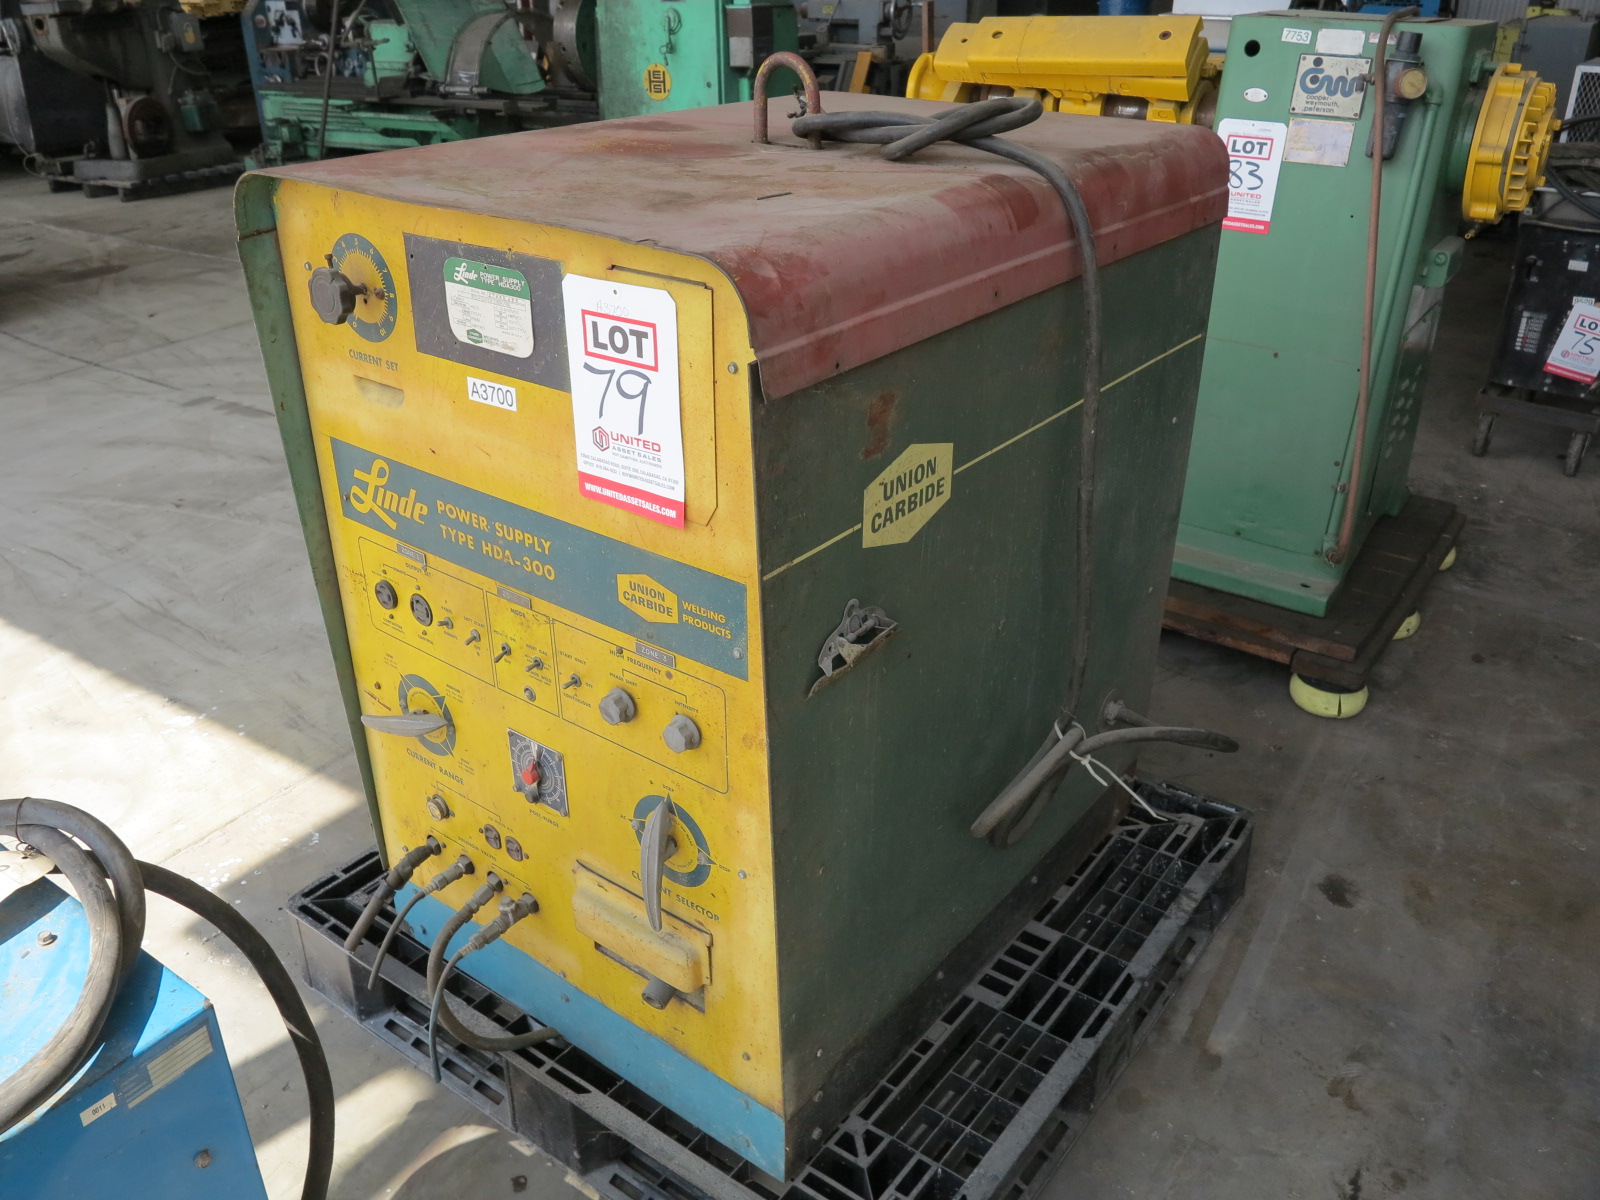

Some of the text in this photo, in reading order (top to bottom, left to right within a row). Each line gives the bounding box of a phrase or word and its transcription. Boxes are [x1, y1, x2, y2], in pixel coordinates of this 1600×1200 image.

[1284, 30, 1310, 42] 7753
[1231, 140, 1268, 155] LOT
[1229, 160, 1264, 190] 83
[1230, 191, 1262, 200] UNITED
[454, 262, 525, 286] Linde POWER SUPPLY
[1579, 318, 1600, 333] LO
[591, 320, 648, 359] LOT
[1571, 330, 1600, 355] 75
[349, 350, 398, 372] CURRENT SET
[471, 382, 514, 408] A3700
[583, 362, 652, 436] 79
[610, 430, 661, 452] UNITED
[612, 446, 662, 462] ASSET SALES
[882, 456, 937, 502] UNION
[350, 459, 552, 555] Linde POWER SUPPLY
[584, 482, 676, 518] WWW.UNITEDASSETSALES.COM
[870, 476, 945, 534] CARBIDE
[402, 546, 415, 558] ZONE
[440, 524, 555, 580] TYPE HDA-300
[629, 580, 666, 602] UNION
[510, 608, 526, 618] MODE
[622, 590, 673, 618] CARBIDE
[682, 600, 726, 624] WELDING
[682, 614, 732, 639] PRODUCTS
[610, 650, 662, 675] HIGH FREQUENCY
[642, 646, 660, 660] ZONE
[563, 693, 592, 708] CONTINUOUS
[674, 700, 699, 713] INTENSITY
[406, 748, 436, 770] CURRENT
[438, 766, 464, 786] RANGE
[632, 870, 720, 922] CUNT SELECTOR
